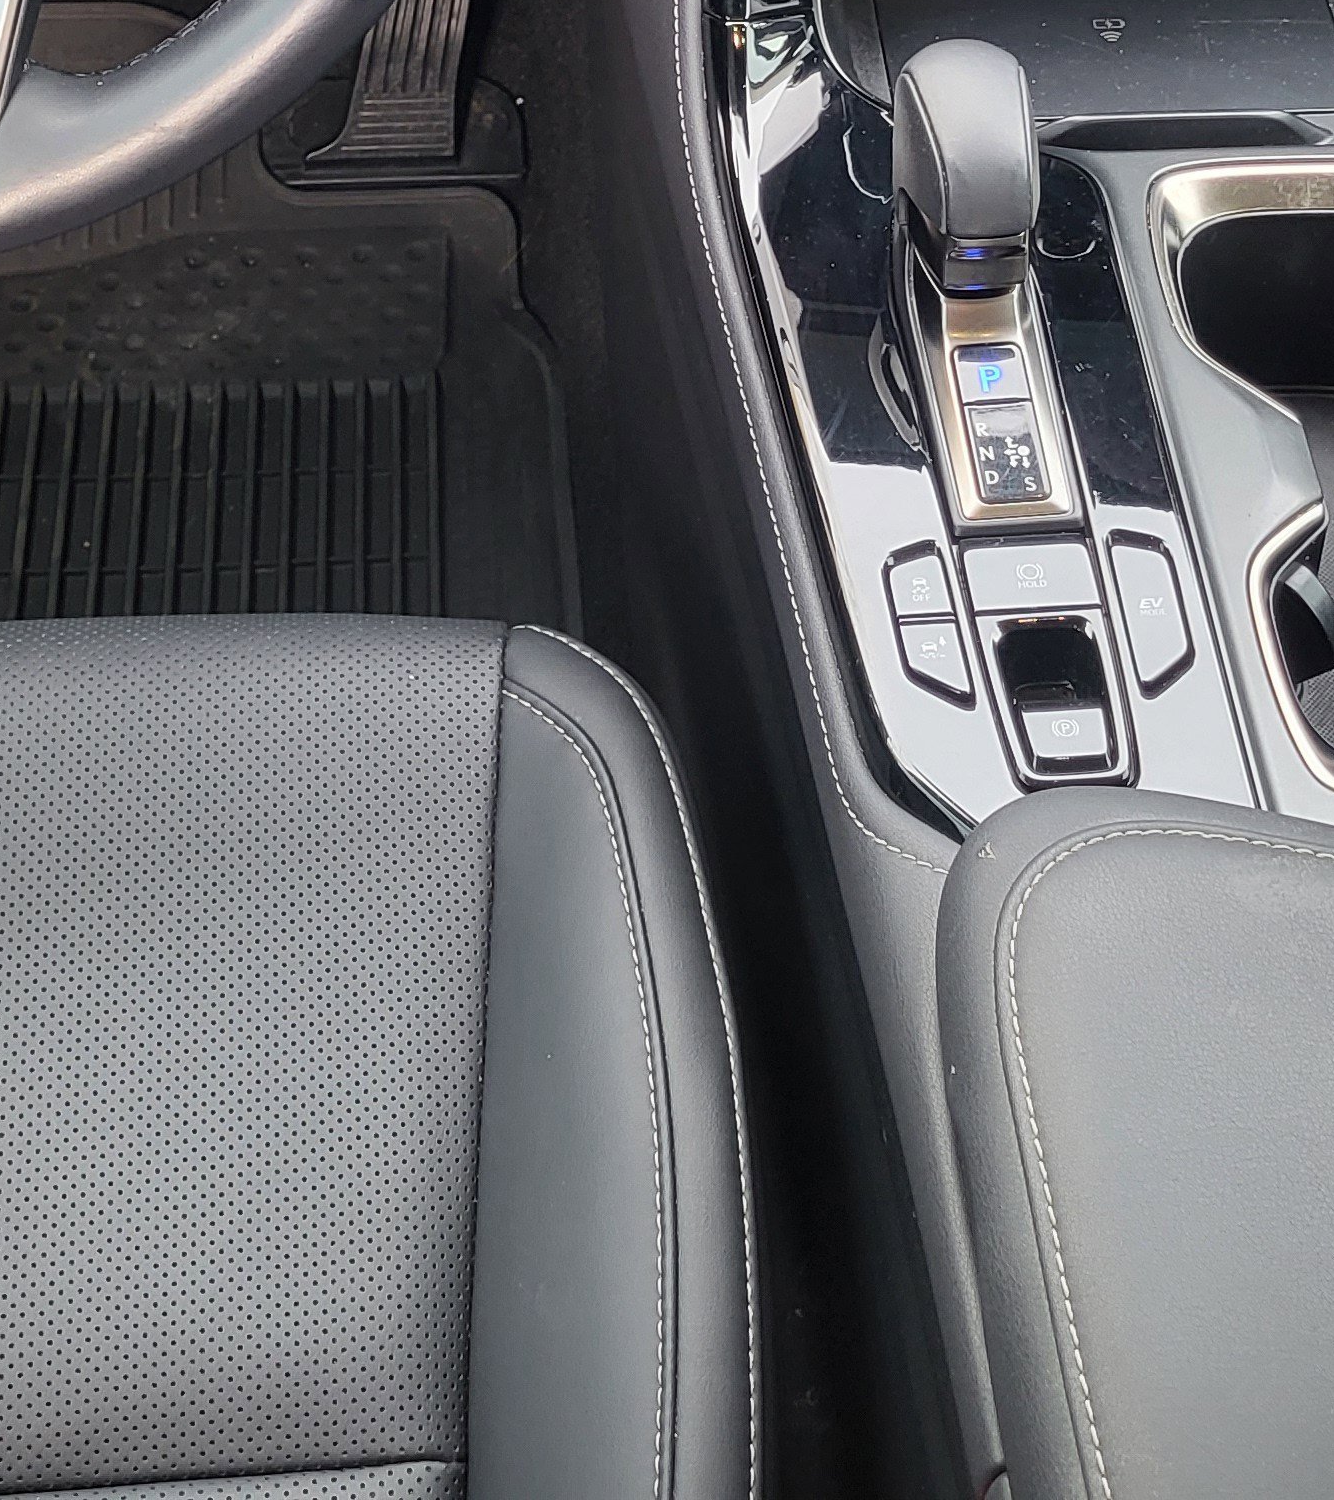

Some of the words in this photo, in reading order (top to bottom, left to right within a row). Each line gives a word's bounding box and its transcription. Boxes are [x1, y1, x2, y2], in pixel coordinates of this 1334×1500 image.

[979, 366, 1003, 392] P
[975, 423, 988, 437] R
[979, 446, 995, 461] N
[985, 471, 1000, 486] D
[1024, 476, 1038, 492] S
[1017, 579, 1048, 589] HOLD
[1139, 597, 1164, 609] EV
